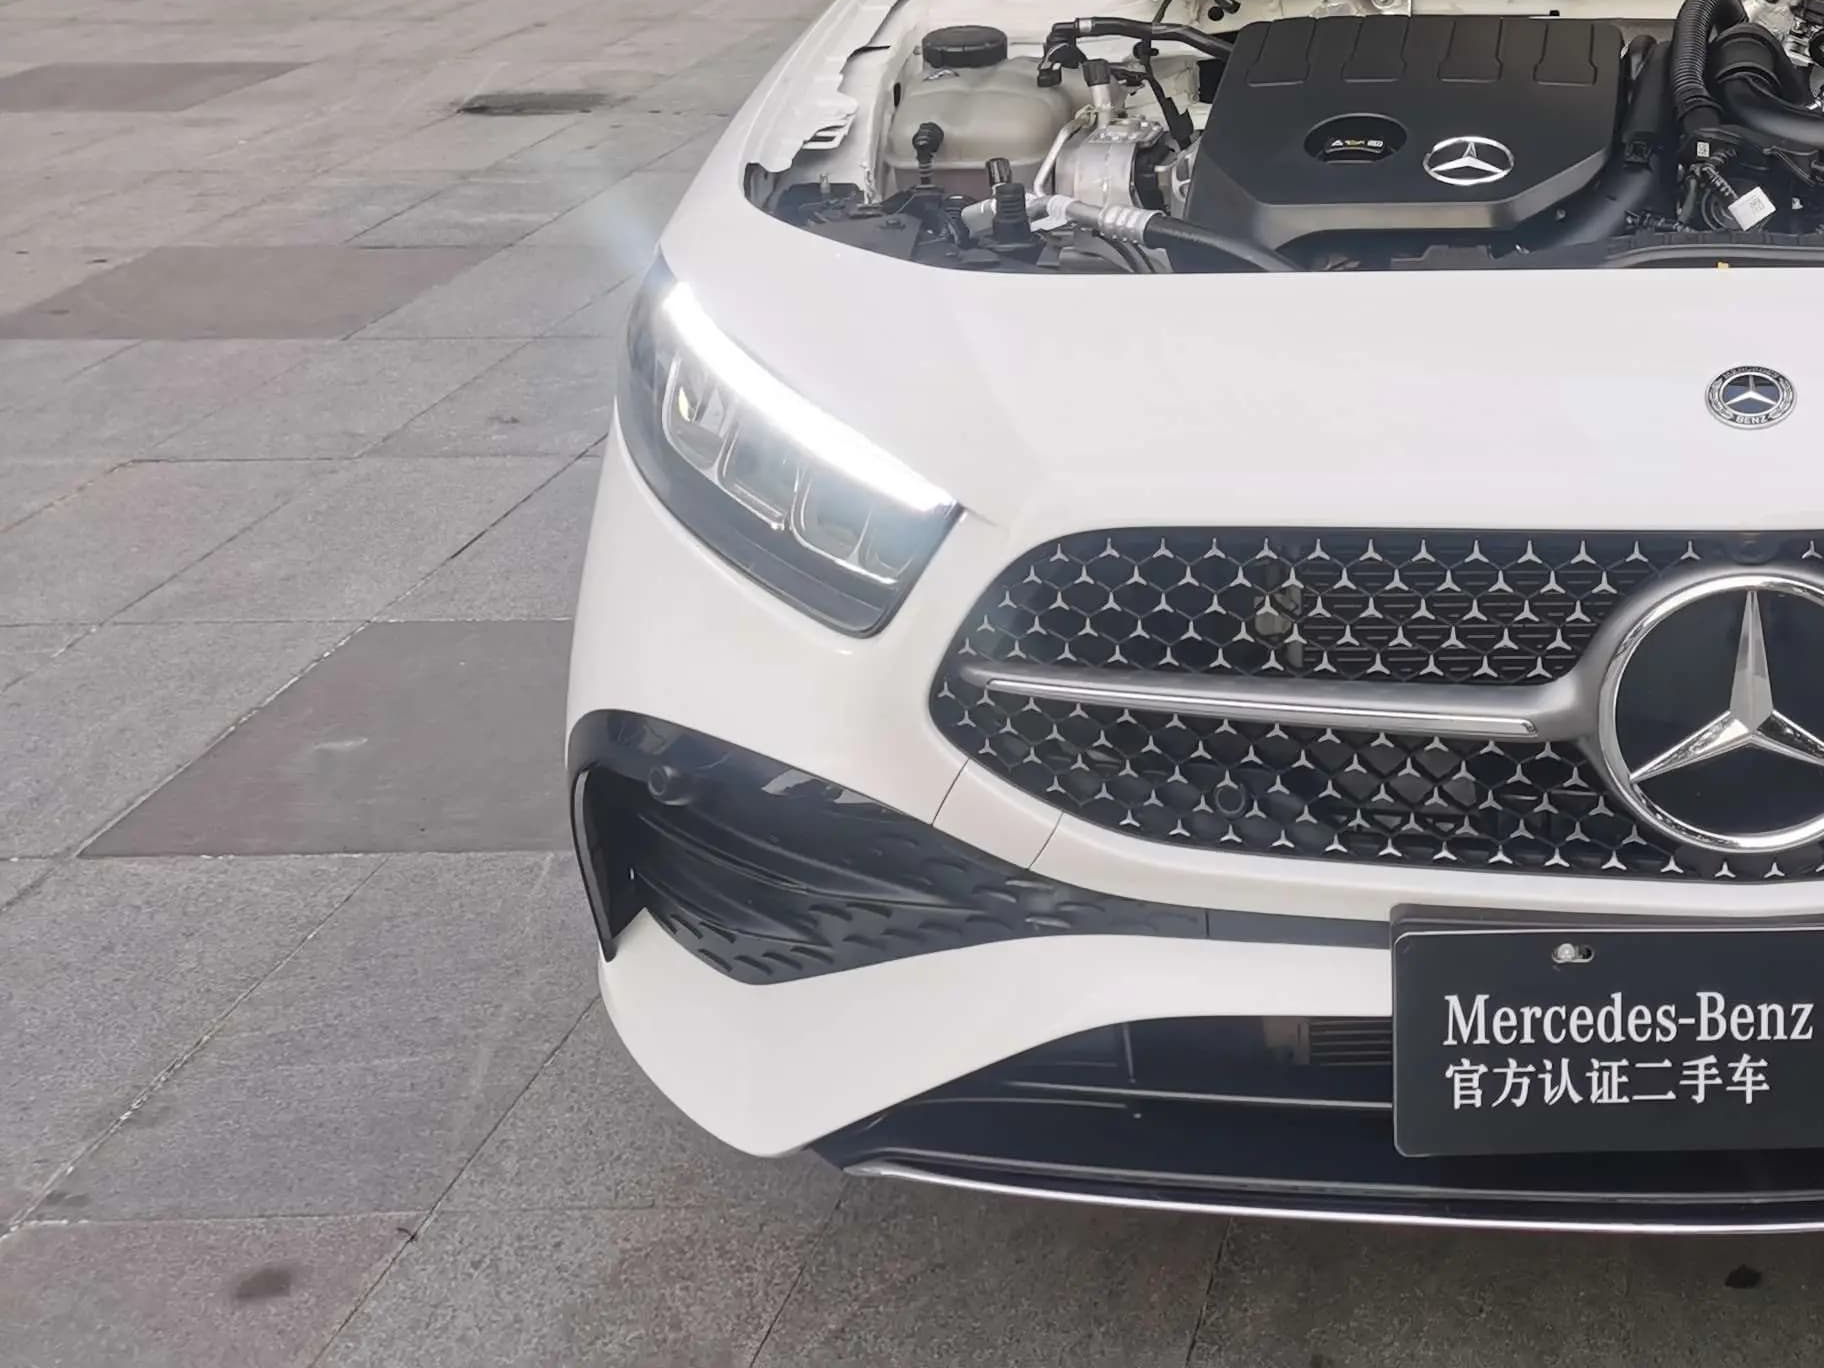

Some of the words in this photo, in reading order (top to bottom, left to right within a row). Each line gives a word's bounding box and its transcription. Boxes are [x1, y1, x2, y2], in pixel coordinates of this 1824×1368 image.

[1442, 991, 1814, 1047] Mercedes-Benz
[1444, 1053, 1771, 1110] 官方认证二手车
